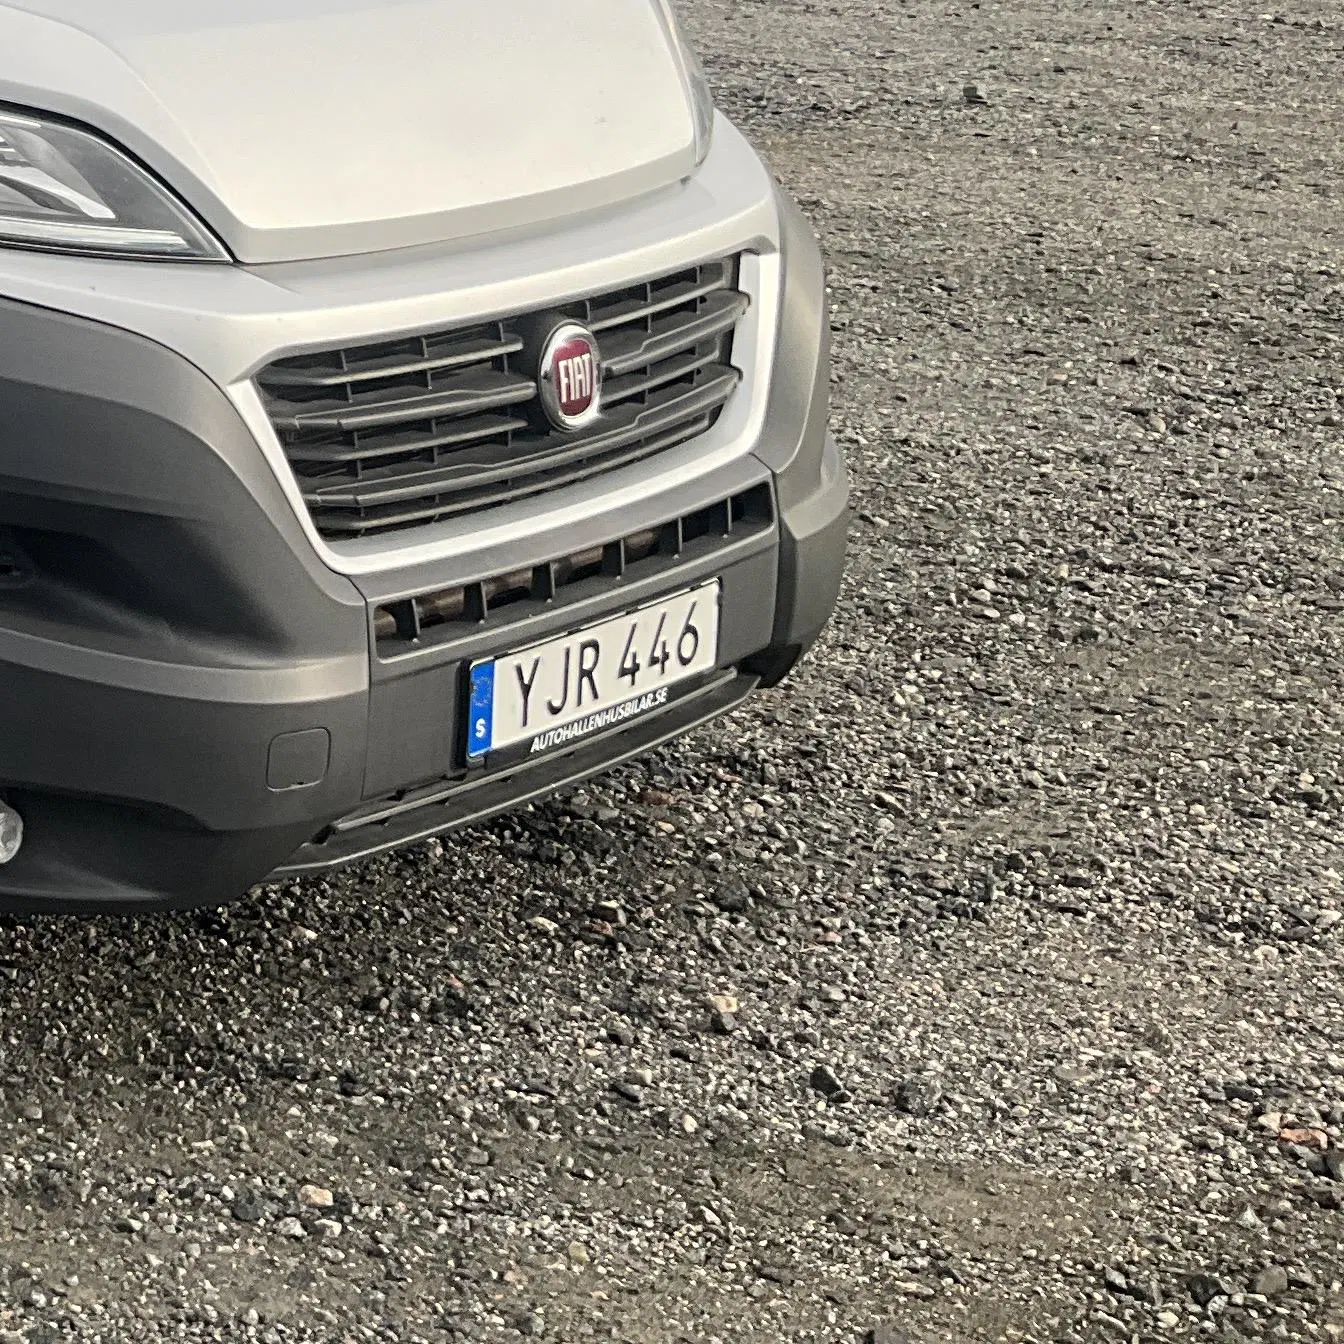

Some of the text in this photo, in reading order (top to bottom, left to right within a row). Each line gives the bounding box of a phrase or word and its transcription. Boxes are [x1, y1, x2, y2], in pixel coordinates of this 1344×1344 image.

[558, 352, 591, 404] FIAT
[514, 599, 700, 727] YJR 446
[474, 718, 487, 739] S
[529, 687, 669, 753] AUTOHALLENHUSBILAR.SE
